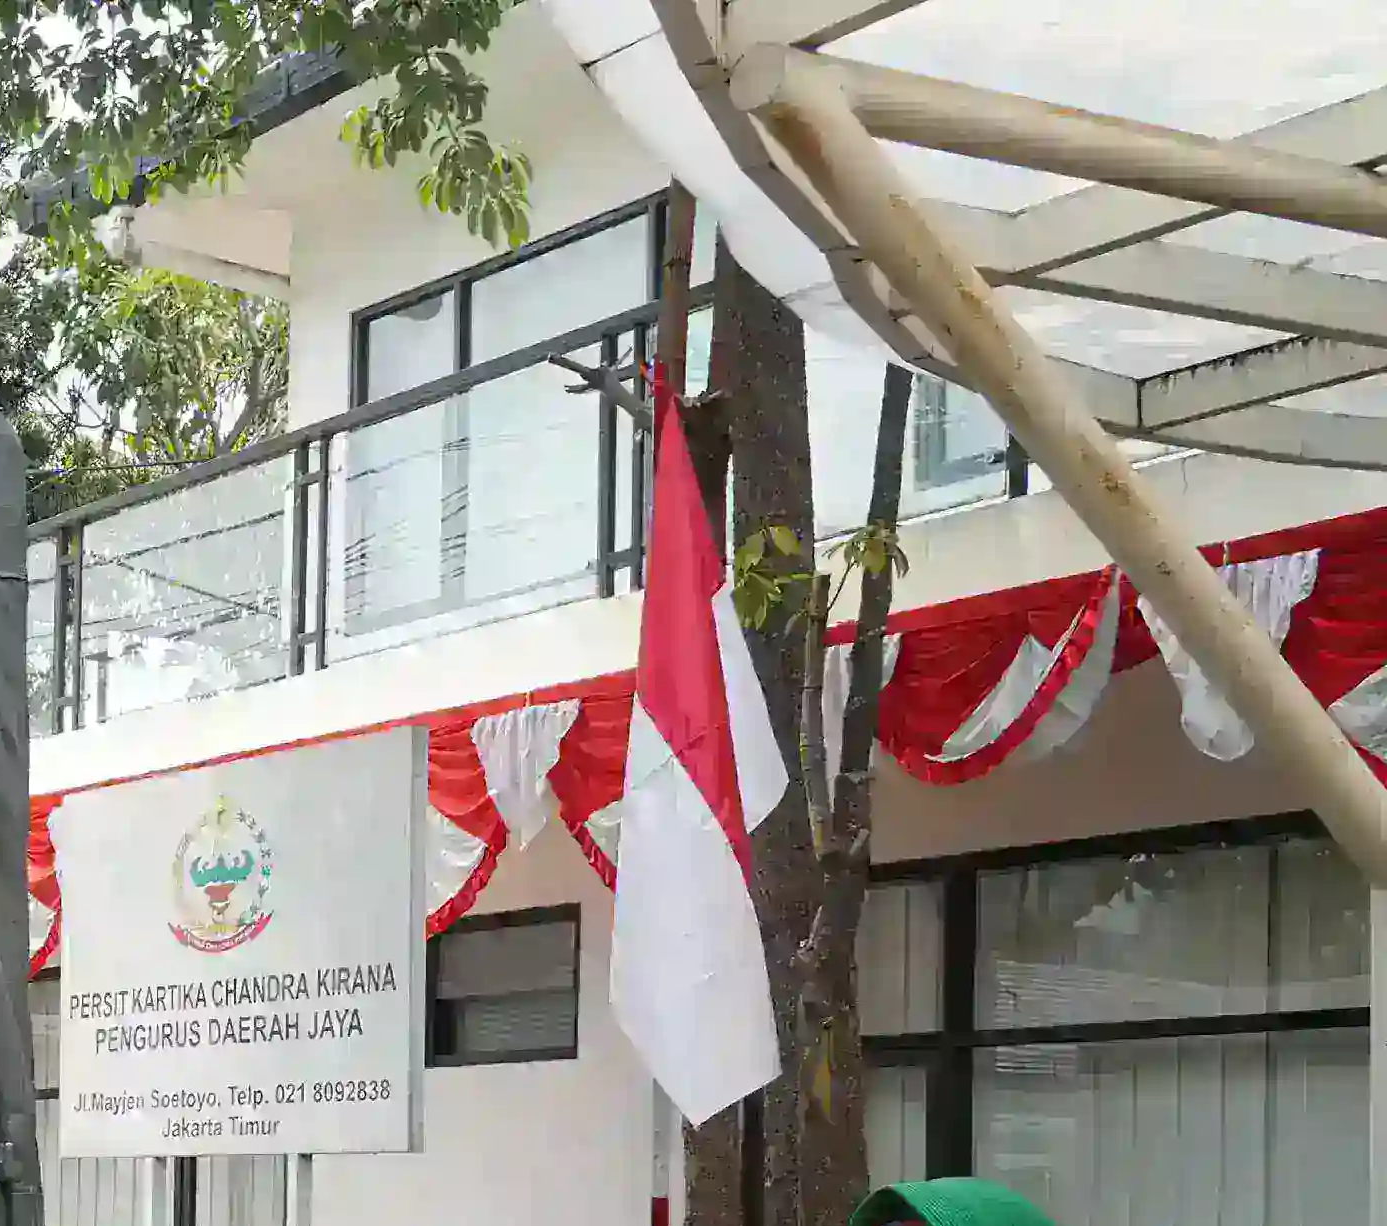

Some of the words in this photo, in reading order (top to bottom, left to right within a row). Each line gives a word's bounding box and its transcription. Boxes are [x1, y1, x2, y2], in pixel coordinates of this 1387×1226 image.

[69, 990, 129, 1020] PERSIT
[131, 982, 207, 1014] KARTIKA
[211, 973, 309, 1007] CHANDRA
[317, 962, 397, 995] KIRANA
[95, 1019, 201, 1054] PENGURUS
[208, 1013, 299, 1045] DAERAH
[307, 1008, 363, 1038] JAYA
[228, 1085, 269, 1108] Telp.
[275, 1083, 306, 1104] 021
[313, 1079, 391, 1101] 8092838
[162, 1117, 223, 1138] Jakarta
[228, 1116, 280, 1136] Timur
